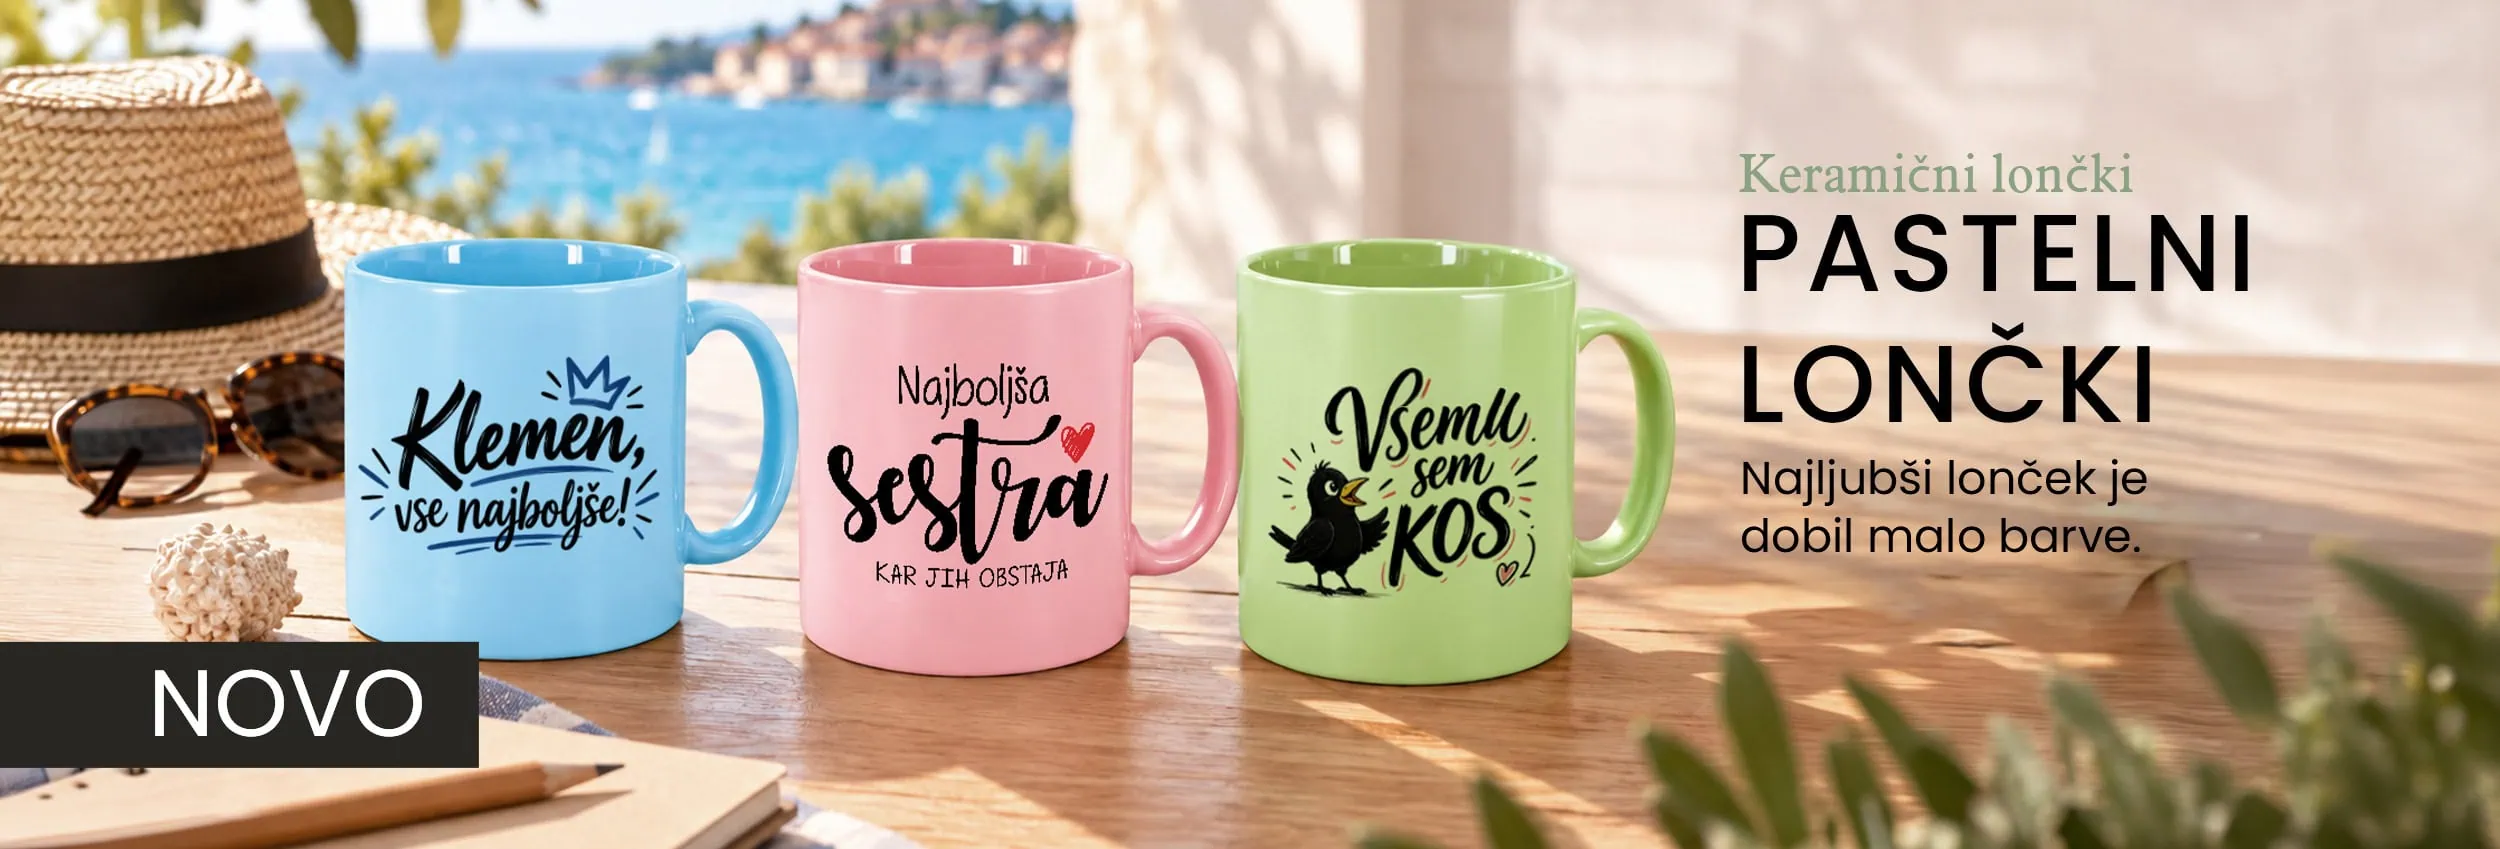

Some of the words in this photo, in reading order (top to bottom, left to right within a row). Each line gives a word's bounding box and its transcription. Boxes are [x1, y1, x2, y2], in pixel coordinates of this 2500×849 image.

[391, 379, 645, 492] Klemen,
[898, 363, 1049, 419] Najboljša
[1324, 367, 1528, 472] Vsemu
[394, 500, 449, 534] vse
[456, 477, 632, 553] najboljše!
[827, 414, 1109, 565] sestra
[1410, 453, 1494, 499] sem
[875, 560, 917, 586] KAR
[925, 566, 969, 589] JIH
[979, 558, 1069, 588] OBSTAJA
[1388, 485, 1512, 587] KOS
